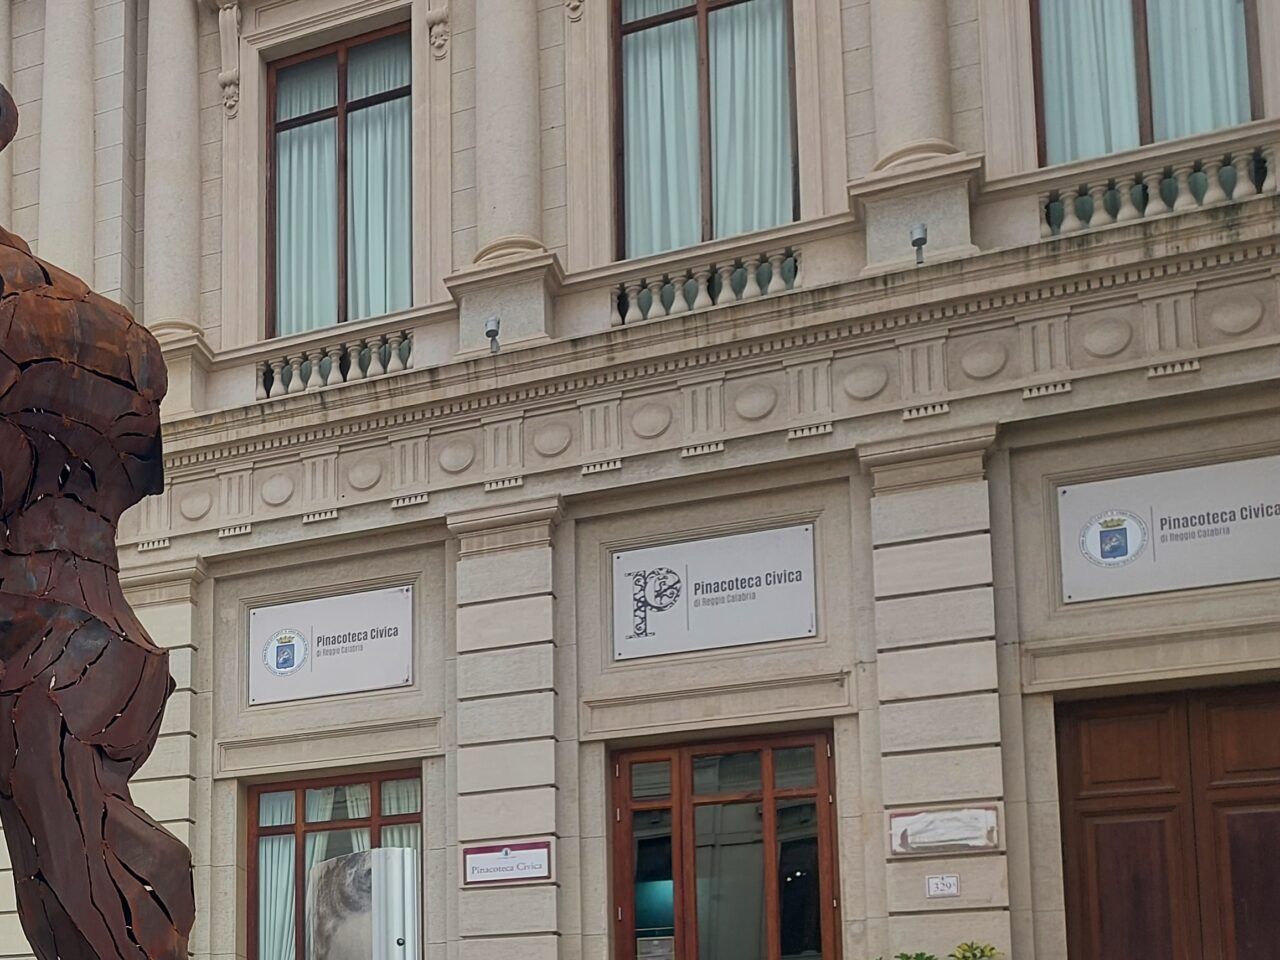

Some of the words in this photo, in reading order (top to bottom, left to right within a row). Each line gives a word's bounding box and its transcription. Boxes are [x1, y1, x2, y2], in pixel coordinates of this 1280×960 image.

[1160, 509, 1236, 531] Pinacoteca
[1240, 502, 1280, 521] Civica
[1160, 533, 1168, 543] di
[1169, 531, 1196, 543] Reggio
[1197, 526, 1230, 540] Calabria
[693, 575, 762, 596] Pinacoteca
[765, 569, 802, 587] Civica
[693, 598, 700, 608] di
[701, 596, 726, 607] Reggio
[726, 592, 756, 603] Calabria
[316, 630, 368, 647] Pinacoteca
[370, 625, 399, 640] Civica
[471, 865, 514, 875] Pinacoteca
[516, 862, 543, 871] Civica
